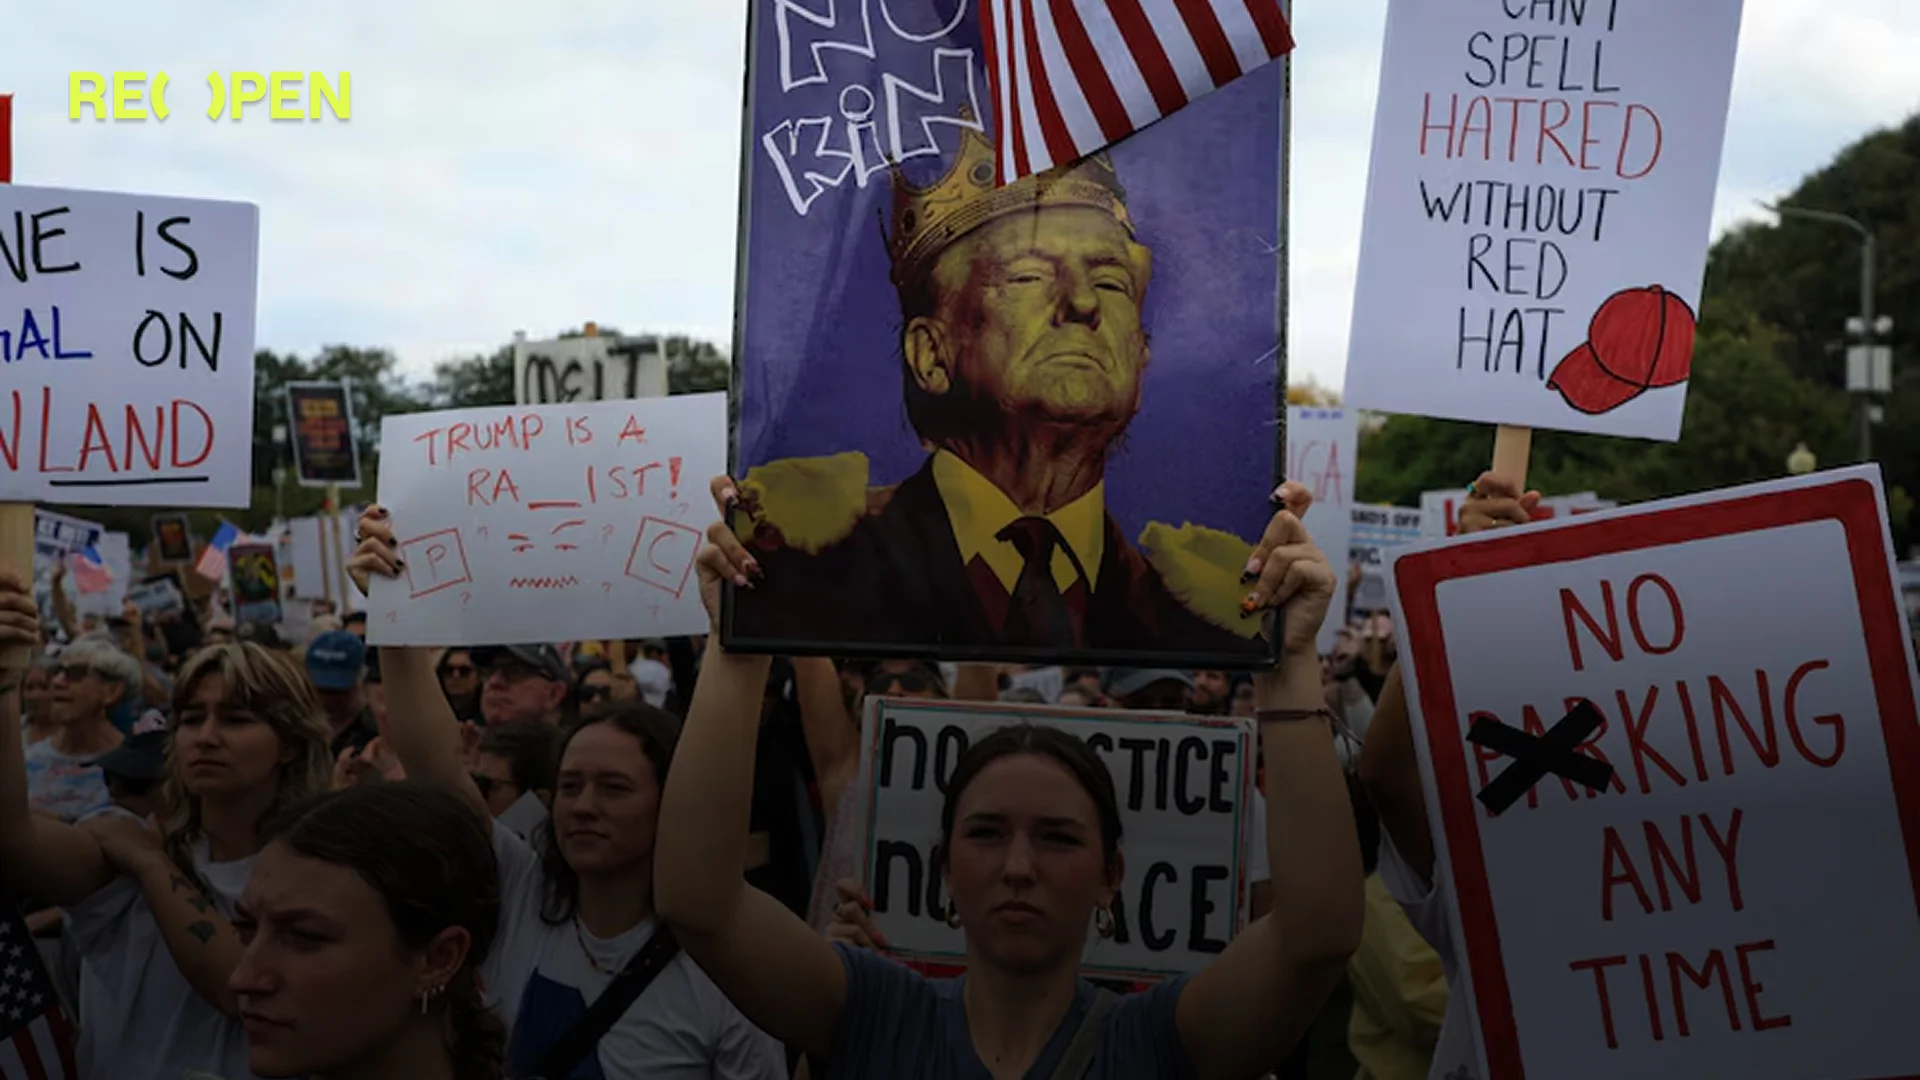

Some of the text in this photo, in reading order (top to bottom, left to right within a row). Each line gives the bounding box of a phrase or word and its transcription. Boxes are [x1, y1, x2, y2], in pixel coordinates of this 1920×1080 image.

[1464, 31, 1621, 93] SPELL
[1419, 92, 1663, 180] HATRED
[1419, 179, 1621, 242] WITHOUT
[134, 209, 200, 281] IS
[1466, 233, 1568, 301] RED
[132, 309, 223, 373] ON
[1456, 307, 1565, 381] HAT
[413, 413, 649, 466] TRUMP IS A
[425, 543, 448, 582] P
[646, 529, 680, 575] C
[1558, 572, 1686, 672] NO
[1602, 807, 1744, 922] ANY
[1568, 938, 1793, 1050] TIME
